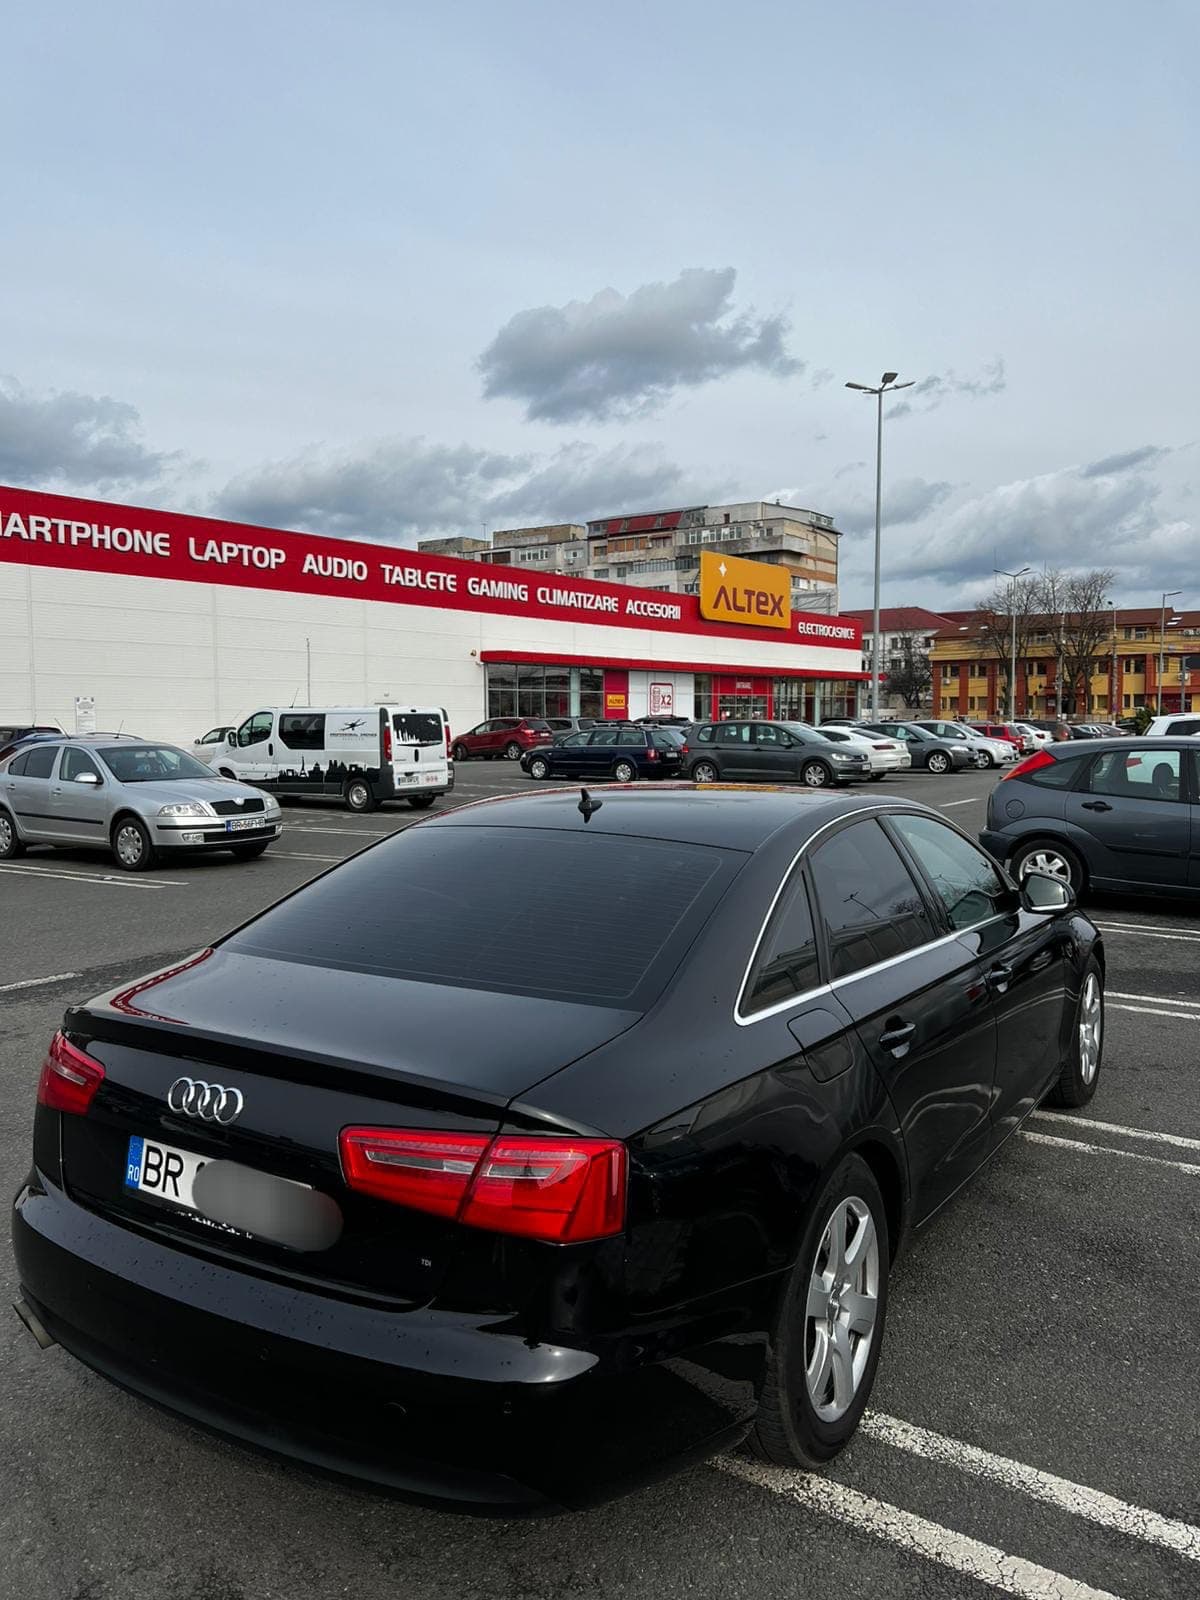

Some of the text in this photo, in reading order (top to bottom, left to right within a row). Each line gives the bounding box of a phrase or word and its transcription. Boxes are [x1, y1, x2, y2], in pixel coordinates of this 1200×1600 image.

[0, 511, 681, 620] ARTPHONE LAPTOP AUDIO TABLETE GAMING CLIMATIZARE ACCESORII
[798, 622, 855, 640] ELECTROCASNICE
[127, 1164, 140, 1182] RO
[142, 1144, 184, 1198] BR
[421, 1258, 432, 1268] TDI
